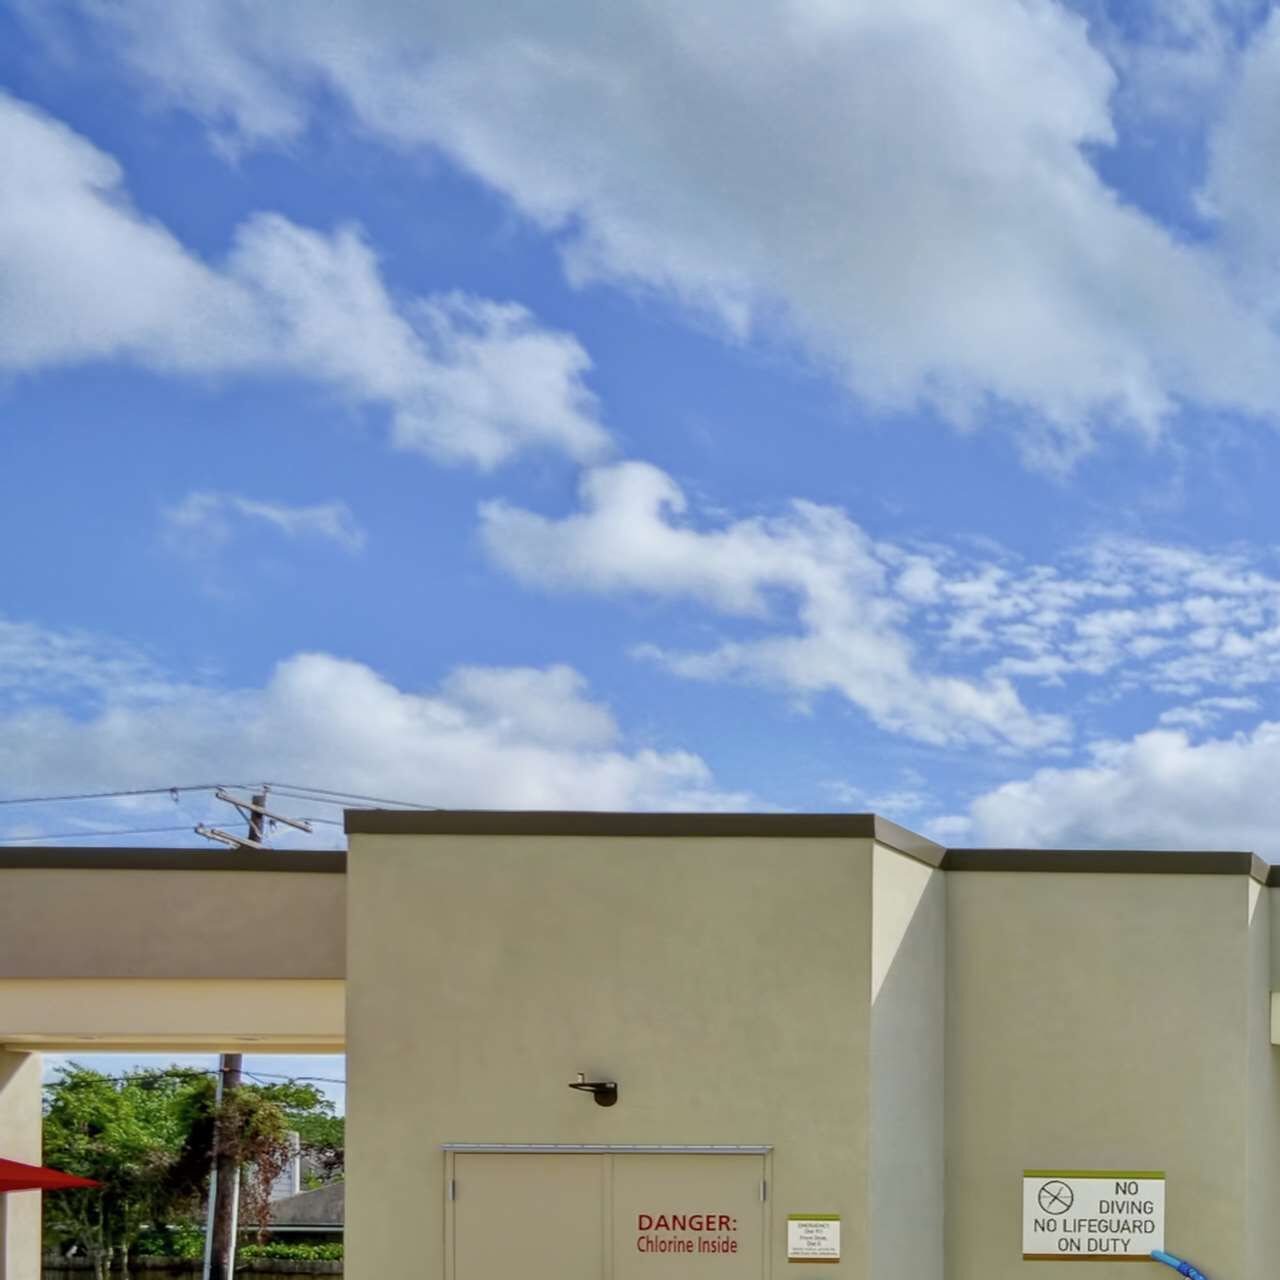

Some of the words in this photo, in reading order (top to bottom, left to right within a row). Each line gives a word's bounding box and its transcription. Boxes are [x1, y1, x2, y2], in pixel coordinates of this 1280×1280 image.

[1115, 1181, 1139, 1196] NO
[1099, 1200, 1154, 1215] DIVING
[637, 1214, 737, 1231] DANGER:
[1034, 1218, 1057, 1233] NO
[1063, 1219, 1155, 1234] LIFEGUARD
[636, 1235, 694, 1253] Chlorine
[698, 1235, 738, 1253] Inside
[1058, 1238, 1081, 1252] ON
[1087, 1238, 1131, 1252] DUTY
